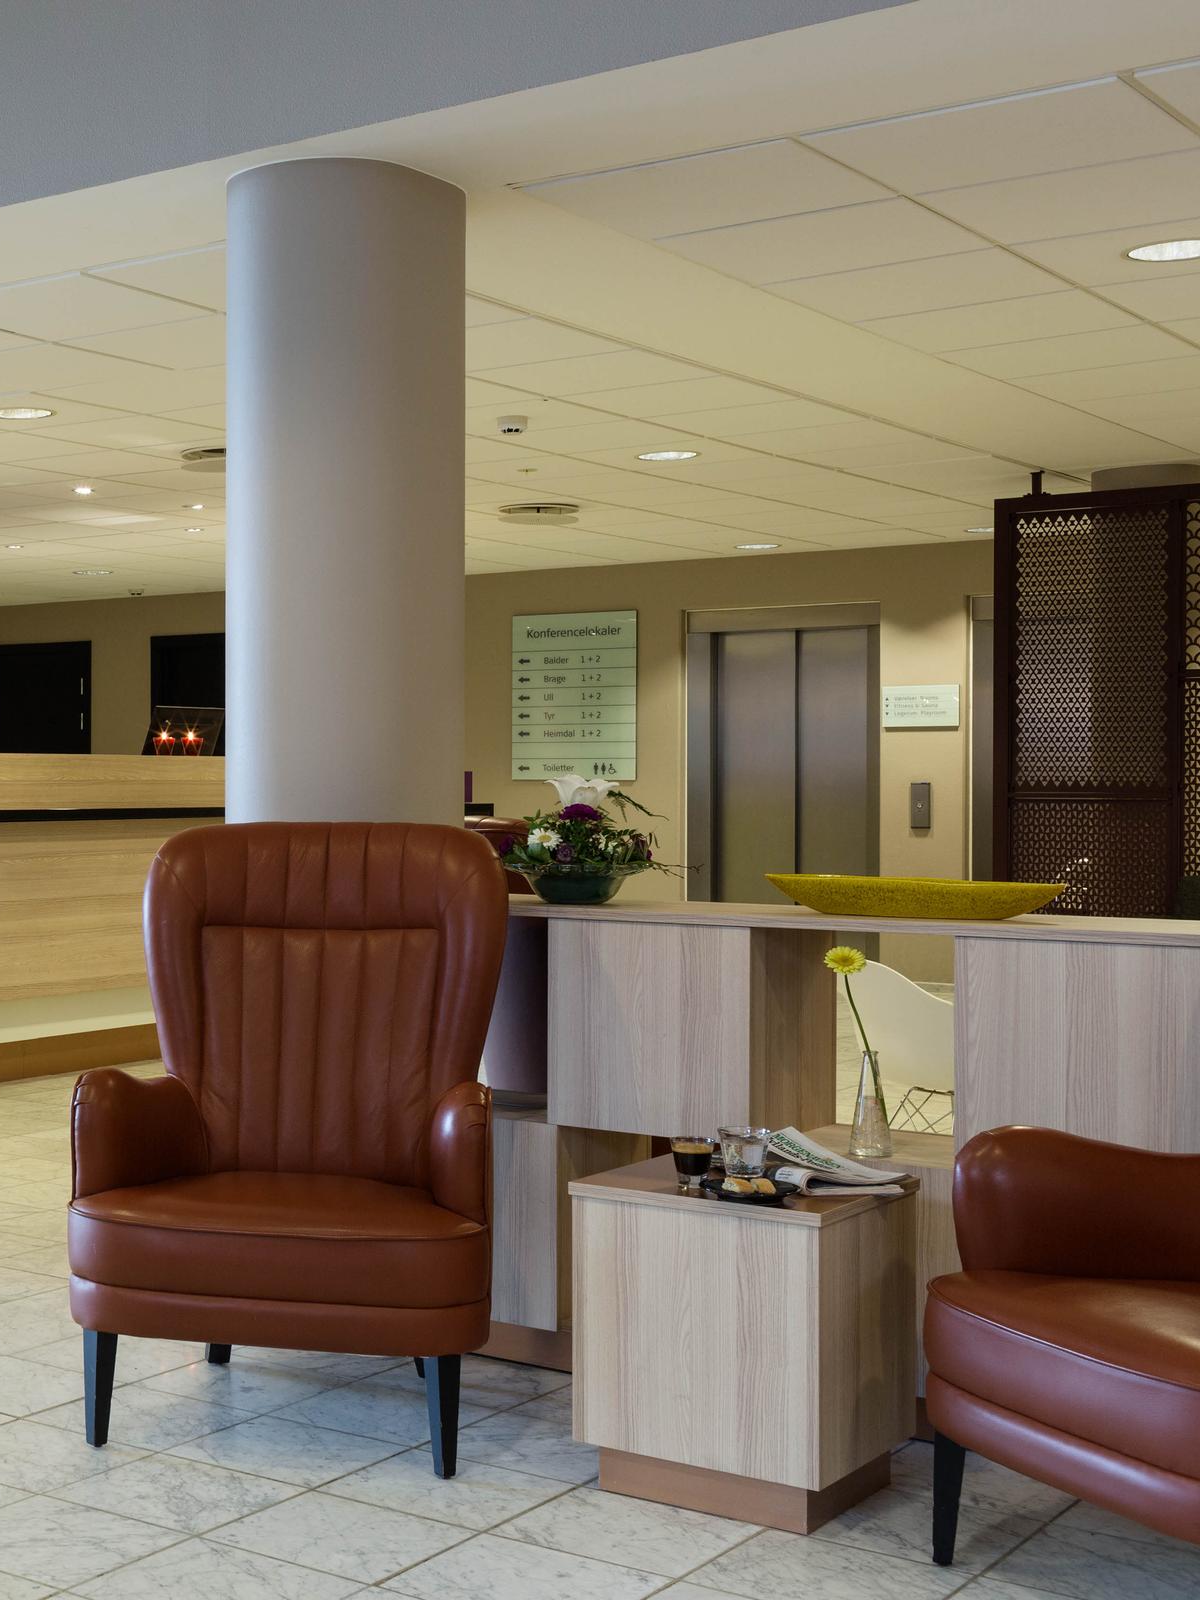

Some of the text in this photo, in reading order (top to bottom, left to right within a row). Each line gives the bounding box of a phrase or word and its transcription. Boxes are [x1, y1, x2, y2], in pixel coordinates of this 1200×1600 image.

[526, 625, 622, 639] Konferencelokaler
[543, 656, 569, 664] Balder
[543, 675, 566, 684] Brage
[544, 712, 555, 720] Tyr
[542, 763, 575, 772] Toiletter
